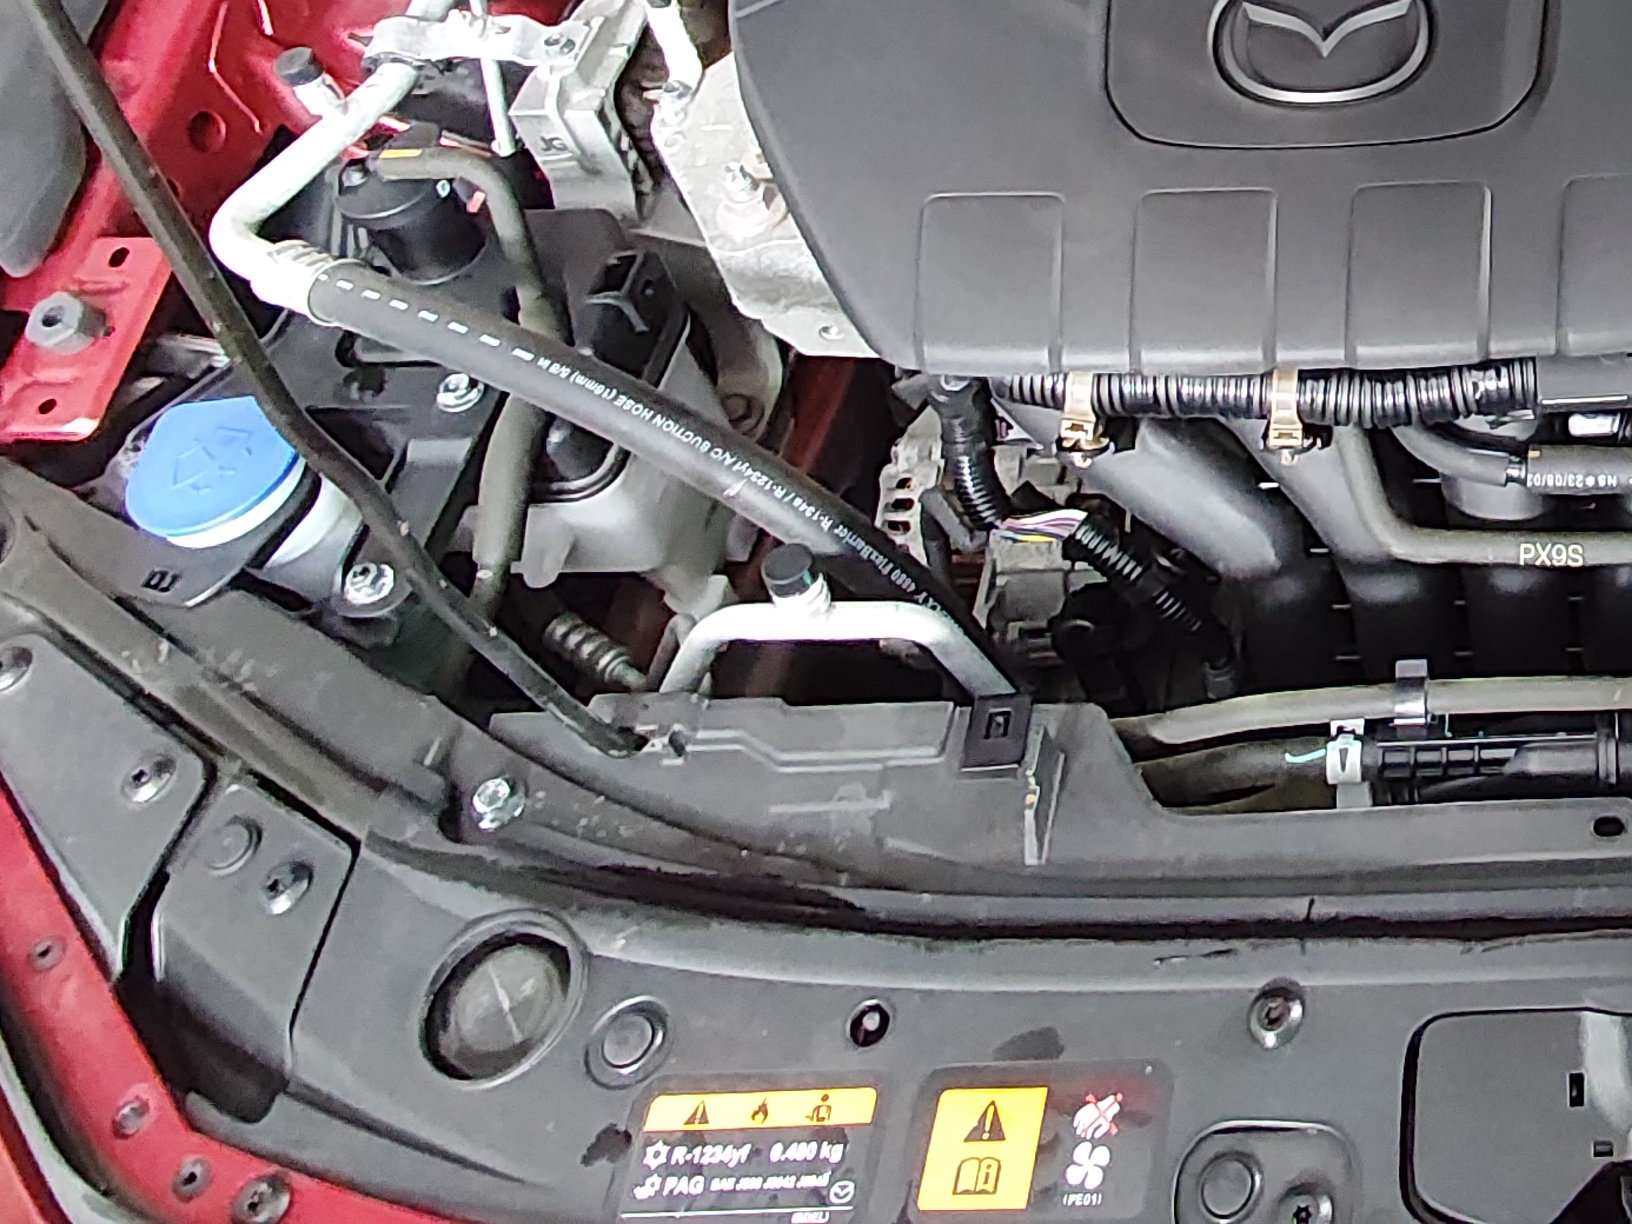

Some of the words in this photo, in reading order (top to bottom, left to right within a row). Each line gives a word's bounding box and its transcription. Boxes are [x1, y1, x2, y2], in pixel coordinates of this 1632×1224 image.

[569, 371, 618, 400] (16mm)
[613, 394, 654, 422] HOSE
[652, 414, 711, 453] SUCTION
[710, 447, 738, 466] A/C
[1519, 543, 1584, 568] PX9S
[819, 1141, 844, 1163] kg
[662, 1177, 704, 1196] PAG
